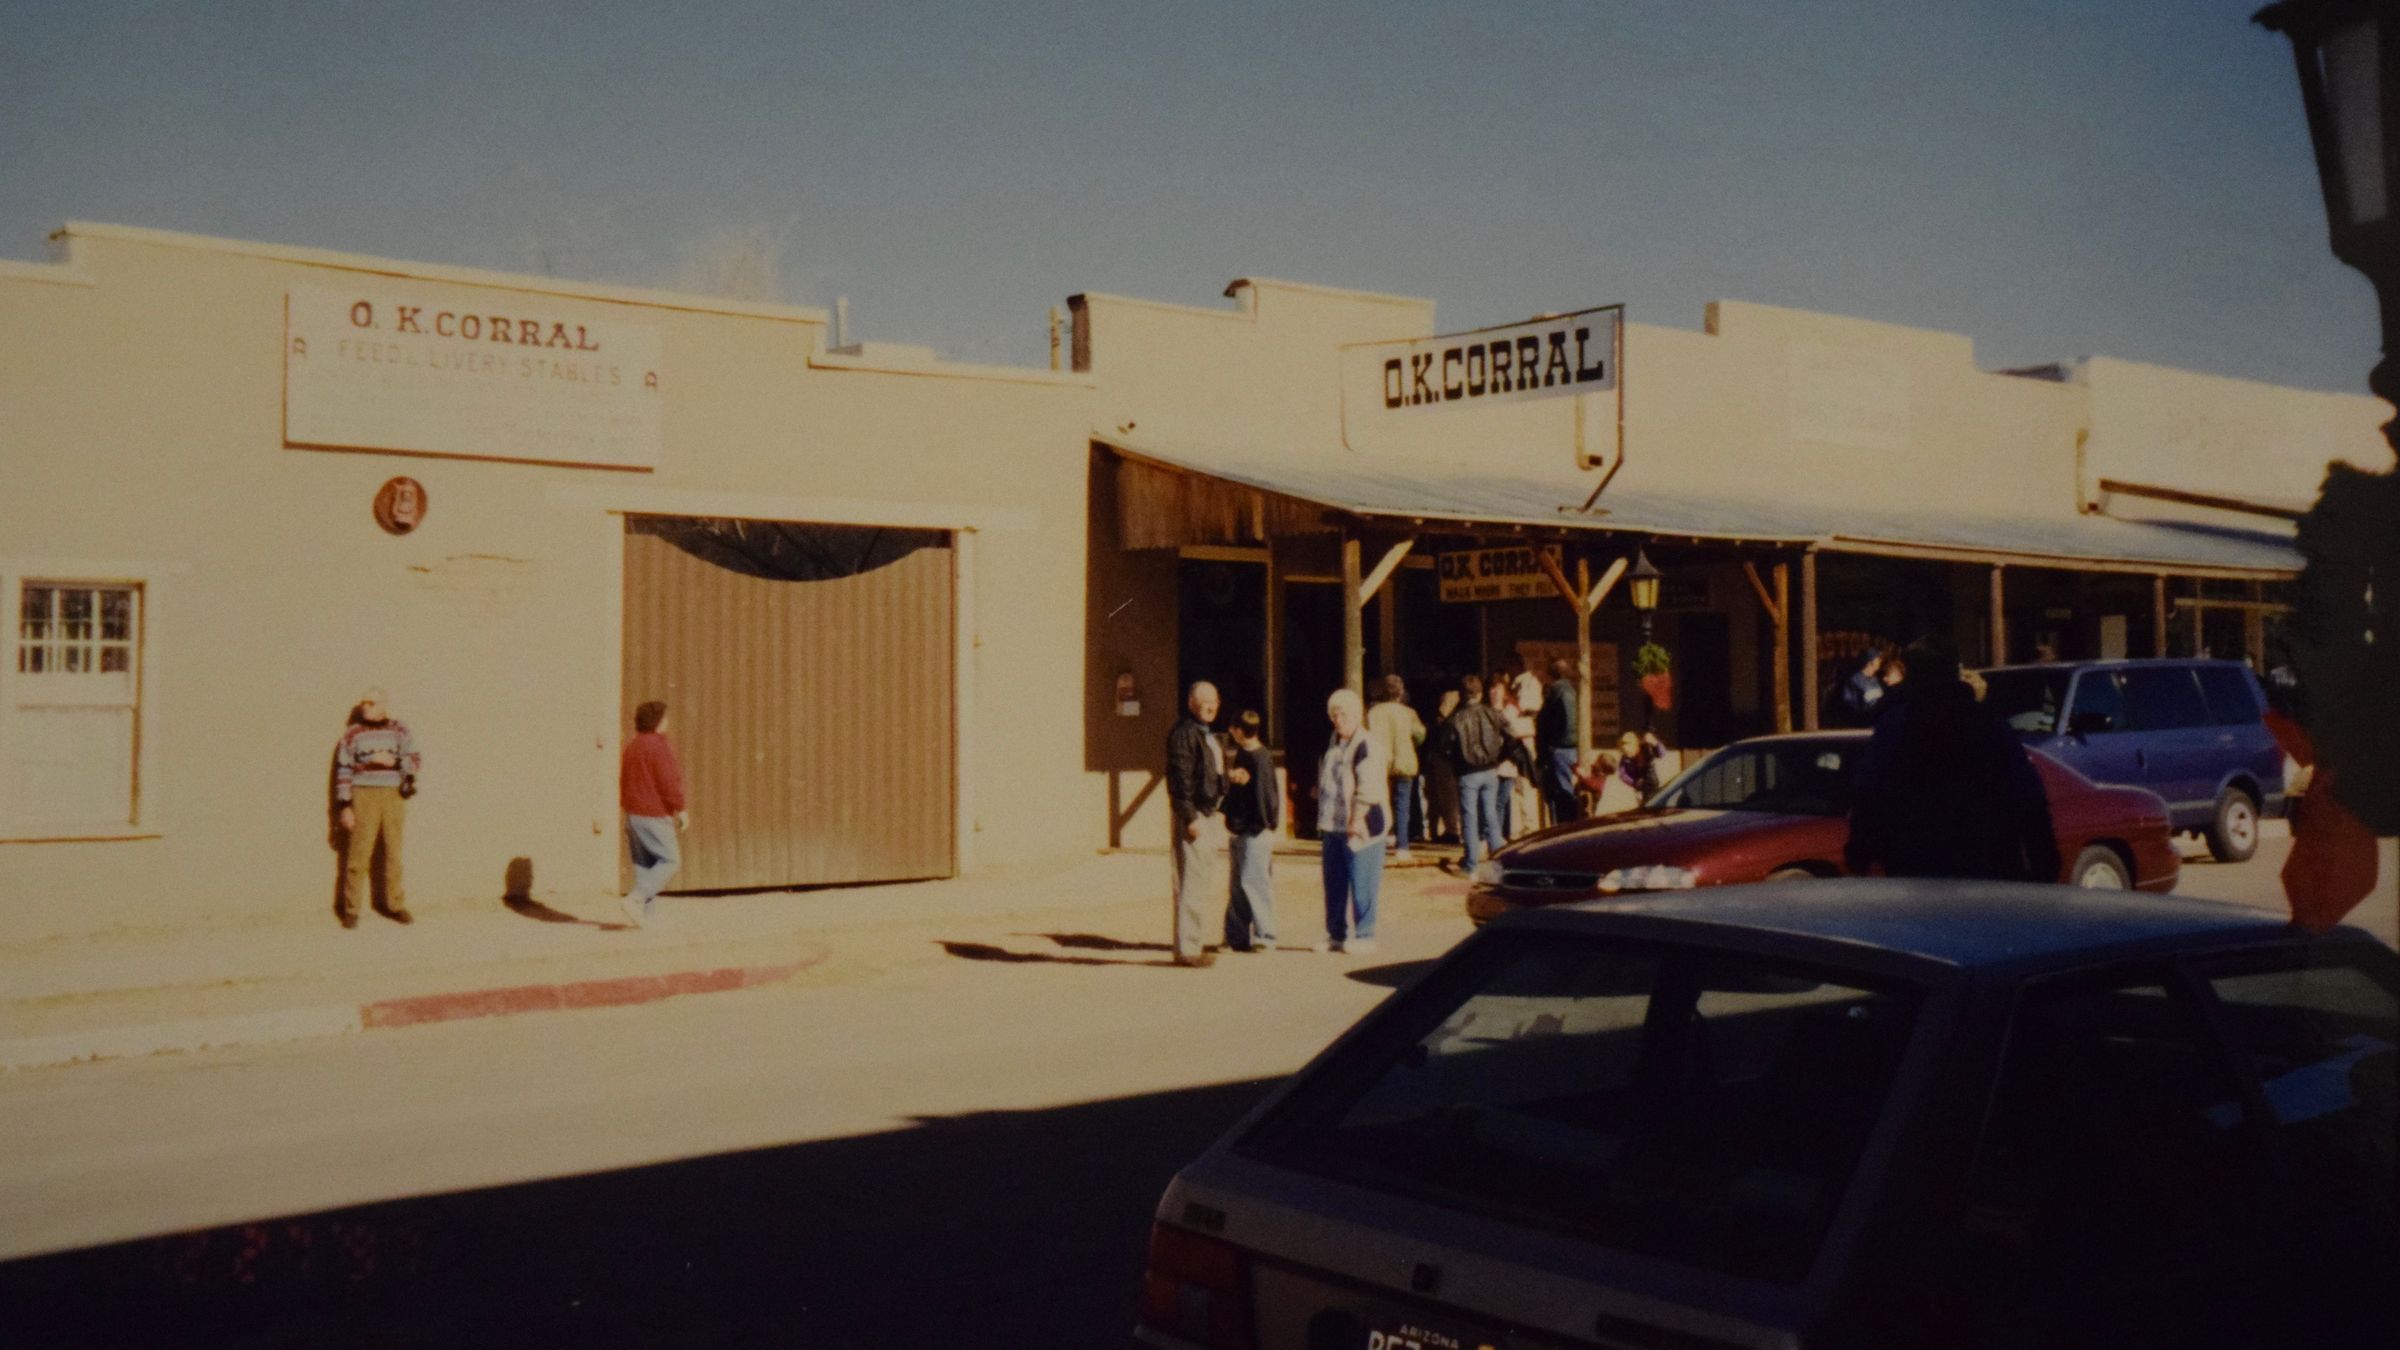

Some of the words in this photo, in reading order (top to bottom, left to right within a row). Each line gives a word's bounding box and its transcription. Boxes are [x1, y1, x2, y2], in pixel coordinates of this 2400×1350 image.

[339, 339, 402, 364] FEED
[520, 358, 621, 386] STABLES
[1400, 1324, 1459, 1349] ARIZONA
